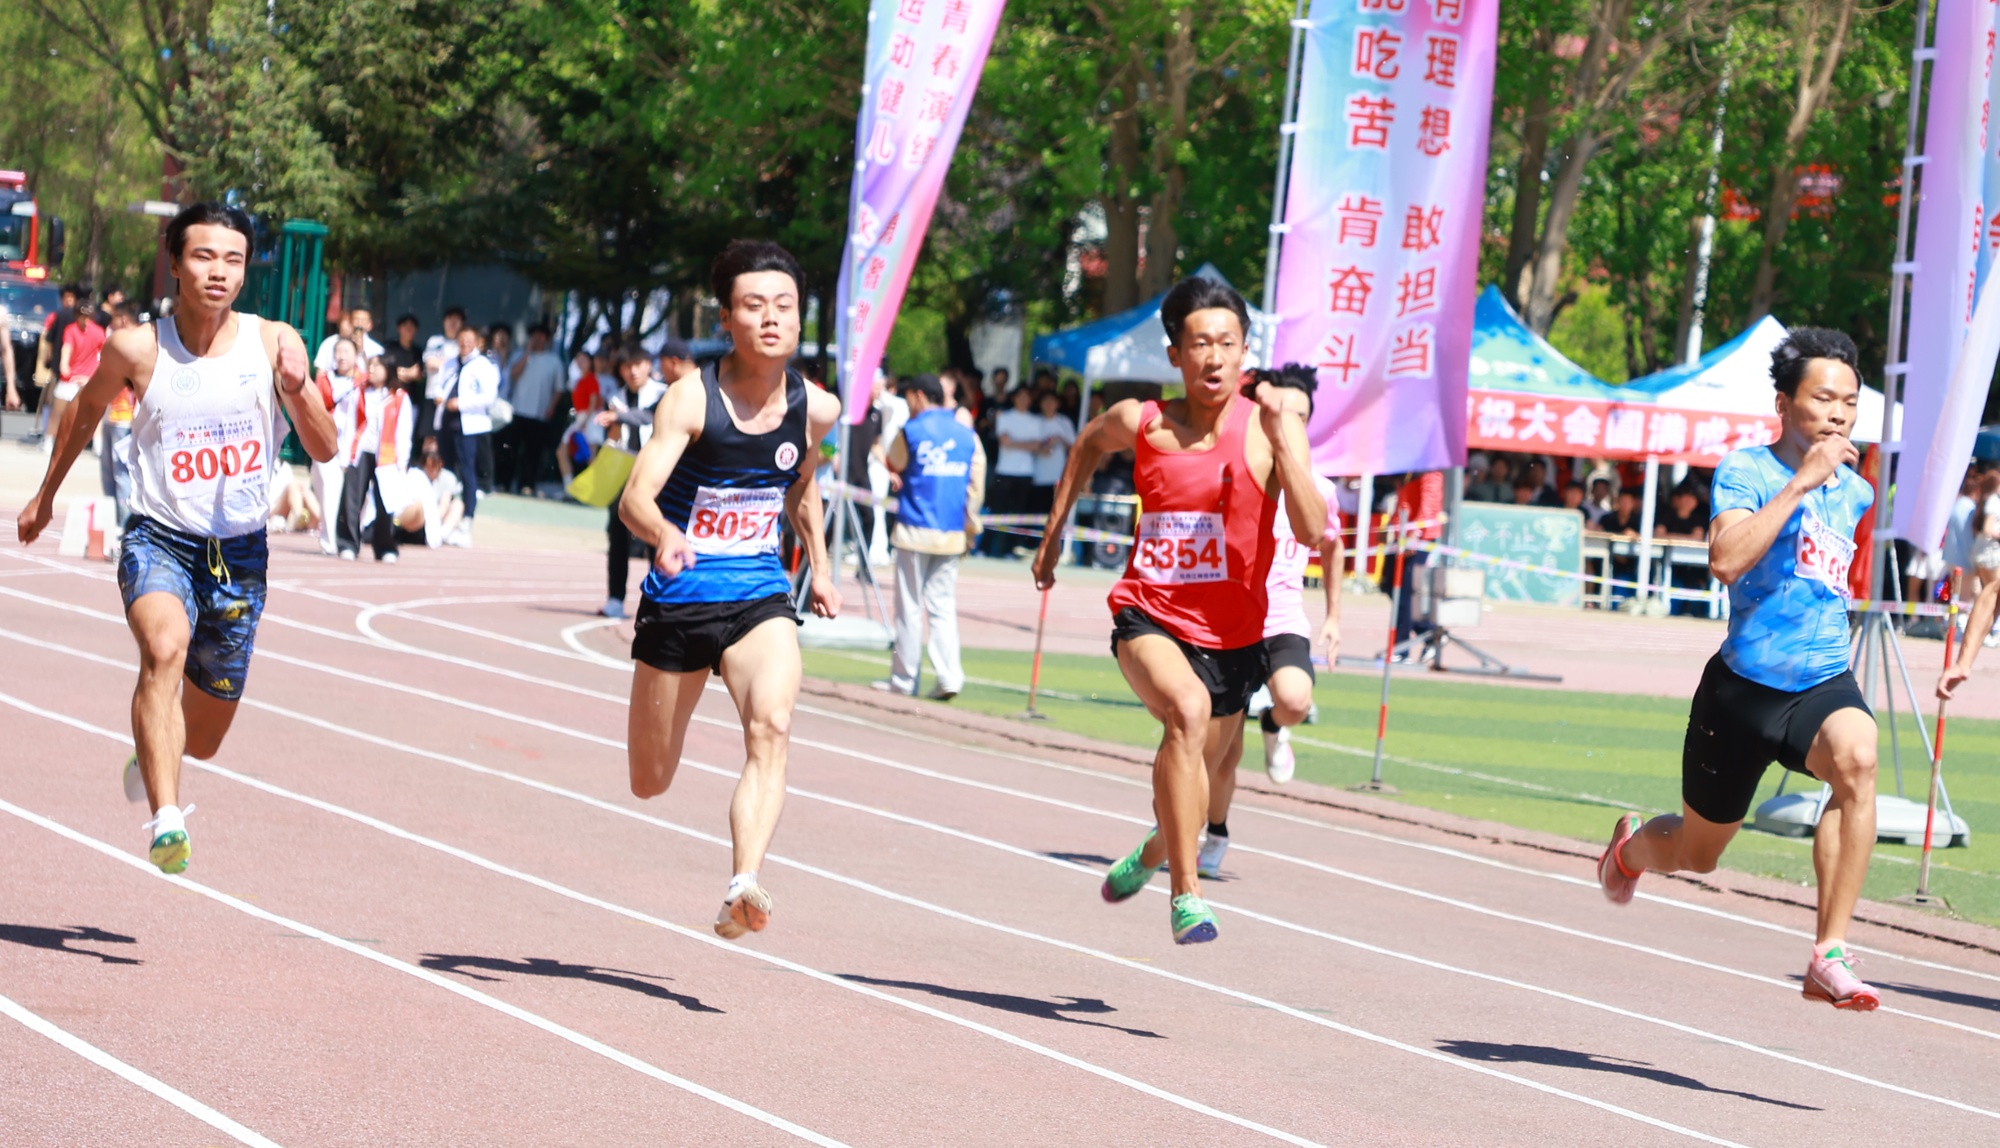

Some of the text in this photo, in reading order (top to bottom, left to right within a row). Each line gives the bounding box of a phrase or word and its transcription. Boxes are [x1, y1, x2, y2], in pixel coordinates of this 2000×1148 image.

[1318, 0, 1405, 382] 吃苦 肯奋斗
[1389, 205, 1444, 375] 敢担当
[1467, 396, 1773, 457] 祝大会圆满成功
[170, 439, 262, 484] 8002
[692, 508, 779, 541] 8057
[1141, 537, 1222, 571] 8354
